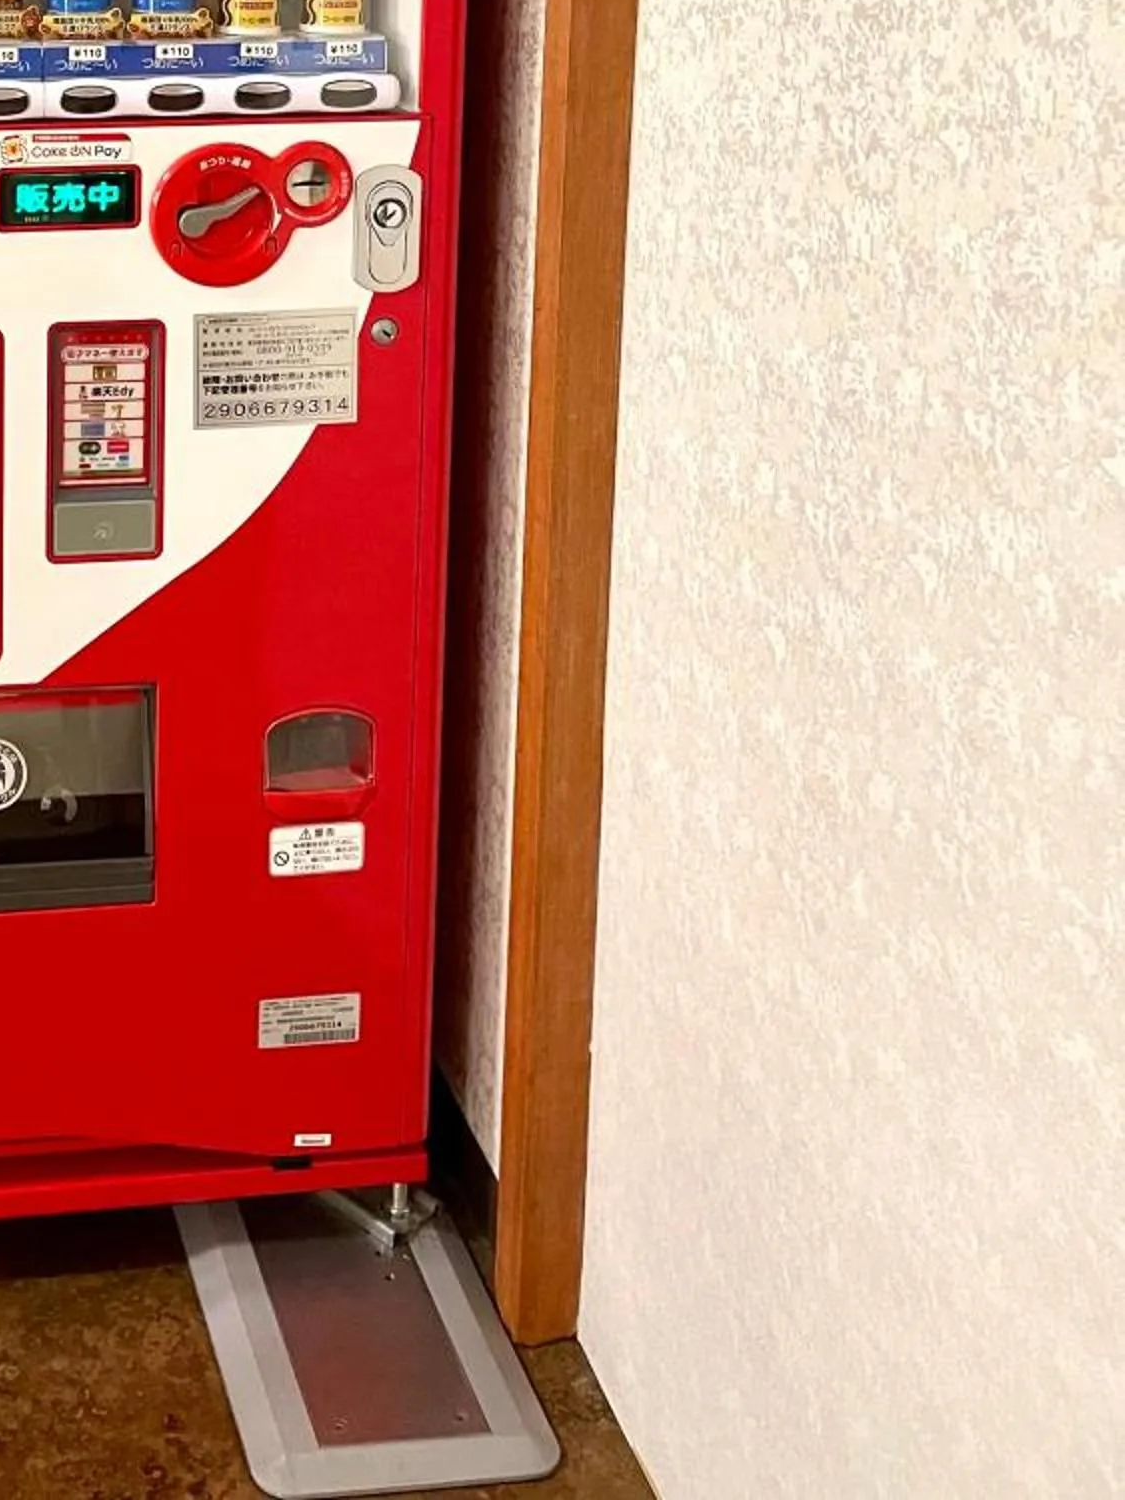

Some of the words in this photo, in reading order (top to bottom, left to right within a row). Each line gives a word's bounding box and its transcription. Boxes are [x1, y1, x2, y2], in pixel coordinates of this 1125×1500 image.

[75, 49, 102, 58] ¥110
[162, 46, 190, 56] ¥110
[245, 46, 273, 56] ¥110
[330, 44, 357, 55] ¥110
[31, 145, 67, 158] Coke
[70, 145, 92, 157] ON
[94, 145, 122, 159] Pay
[14, 181, 121, 213] 販売中
[91, 385, 135, 397] 楽天Edy
[203, 398, 350, 420] 2906679314
